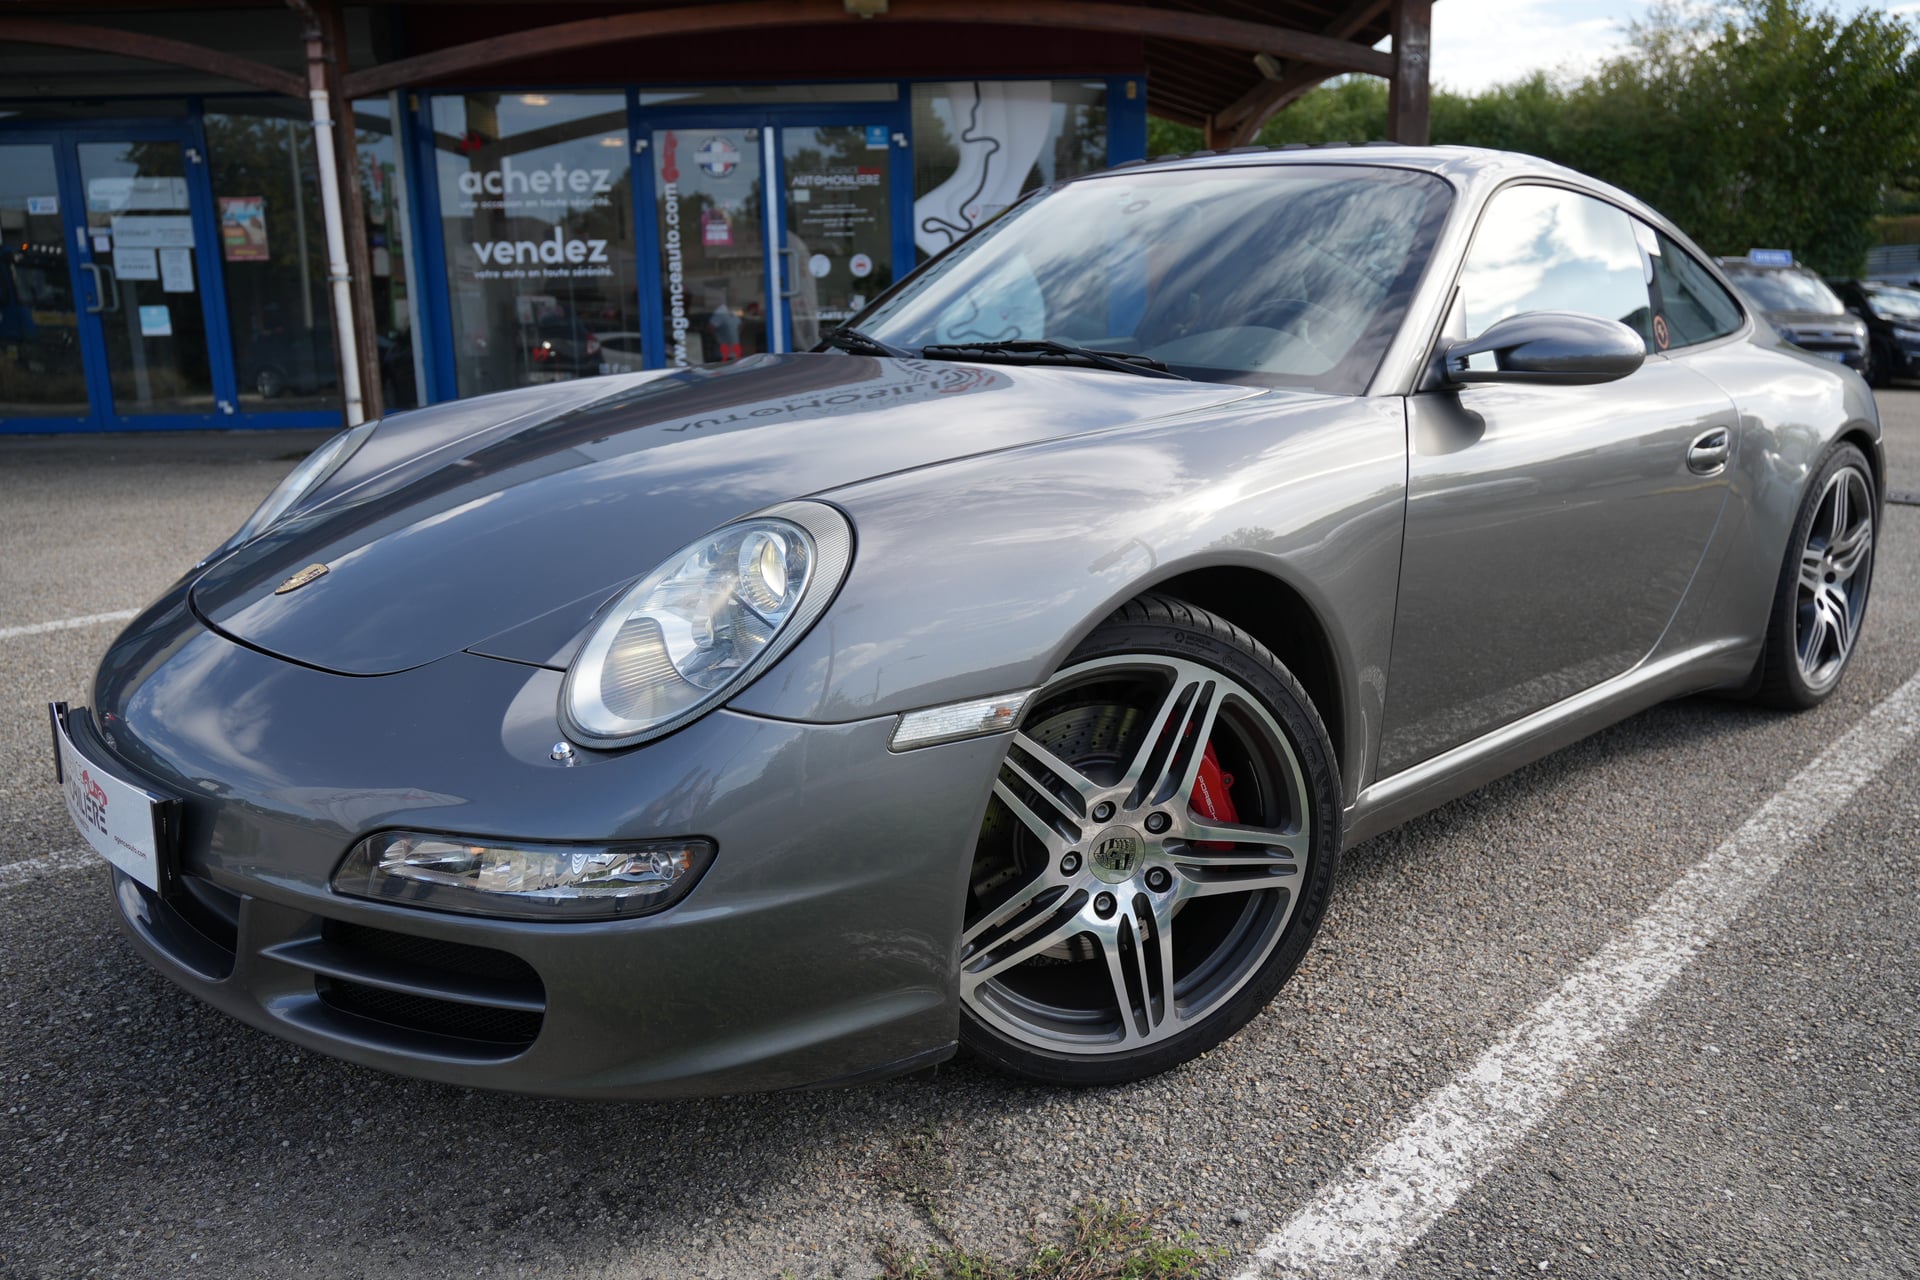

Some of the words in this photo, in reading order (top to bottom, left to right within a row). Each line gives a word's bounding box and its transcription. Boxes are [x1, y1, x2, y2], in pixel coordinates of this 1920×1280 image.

[458, 157, 612, 195] achetez
[472, 225, 608, 265] vendez
[473, 268, 500, 279] votre
[502, 268, 526, 278] auto
[528, 269, 541, 278] en
[543, 266, 569, 278] toute
[1197, 775, 1218, 821] PORSCH
[1306, 802, 1333, 922] MICHELIN
